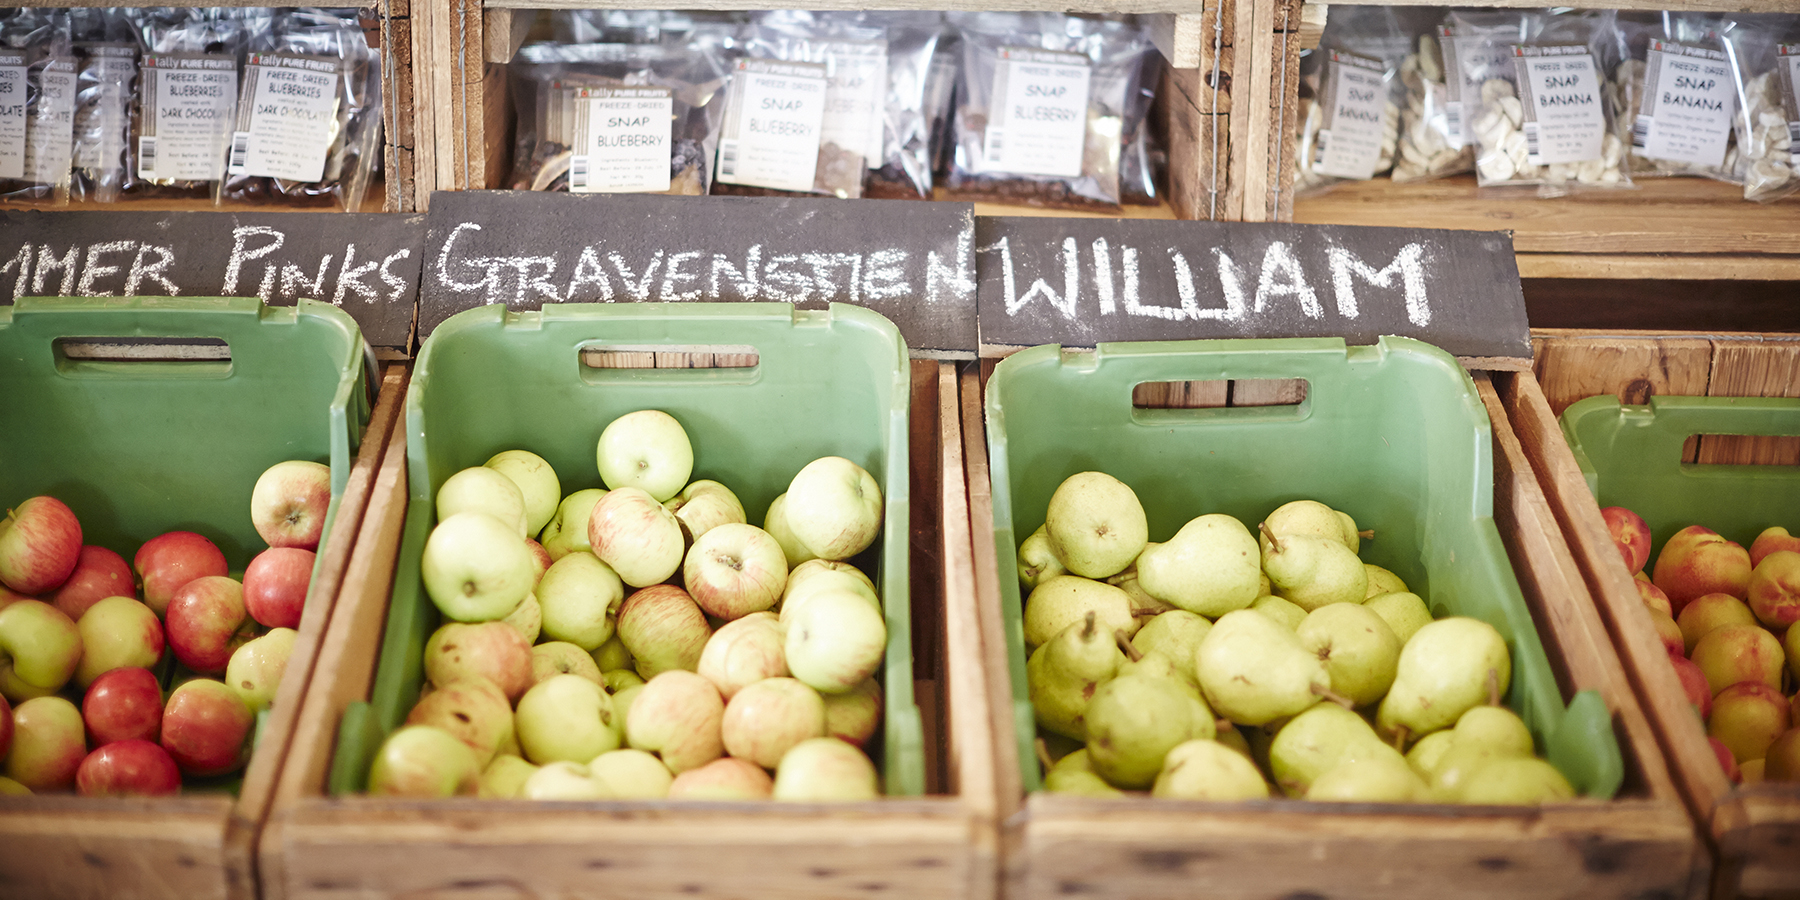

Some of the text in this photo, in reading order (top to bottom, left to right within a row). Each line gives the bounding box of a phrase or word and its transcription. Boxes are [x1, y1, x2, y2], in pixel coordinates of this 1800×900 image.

[142, 54, 233, 69] Totally PURE FRUITS
[248, 52, 336, 72] Totally PURE FRUITS
[1545, 74, 1580, 89] SNAP
[1674, 76, 1716, 92] SNAP
[170, 85, 223, 97] BLUEBERRIES
[269, 82, 321, 99] BLUEBERRIES
[576, 87, 668, 99] Totally PURE FRUITS
[1025, 84, 1067, 98] SNAP
[760, 97, 802, 111] SNAP
[1540, 93, 1593, 108] BANANA
[1662, 91, 1723, 112] BANANA
[162, 107, 182, 119] DARK
[257, 104, 279, 115] DARK
[1014, 105, 1078, 122] BLUEBERRY
[1338, 104, 1380, 122] BANANA
[607, 116, 650, 127] SNAP
[750, 118, 814, 136] BLUEBERRY
[597, 134, 664, 147] BLUEBERRY
[980, 235, 1434, 328] WILLIAM
